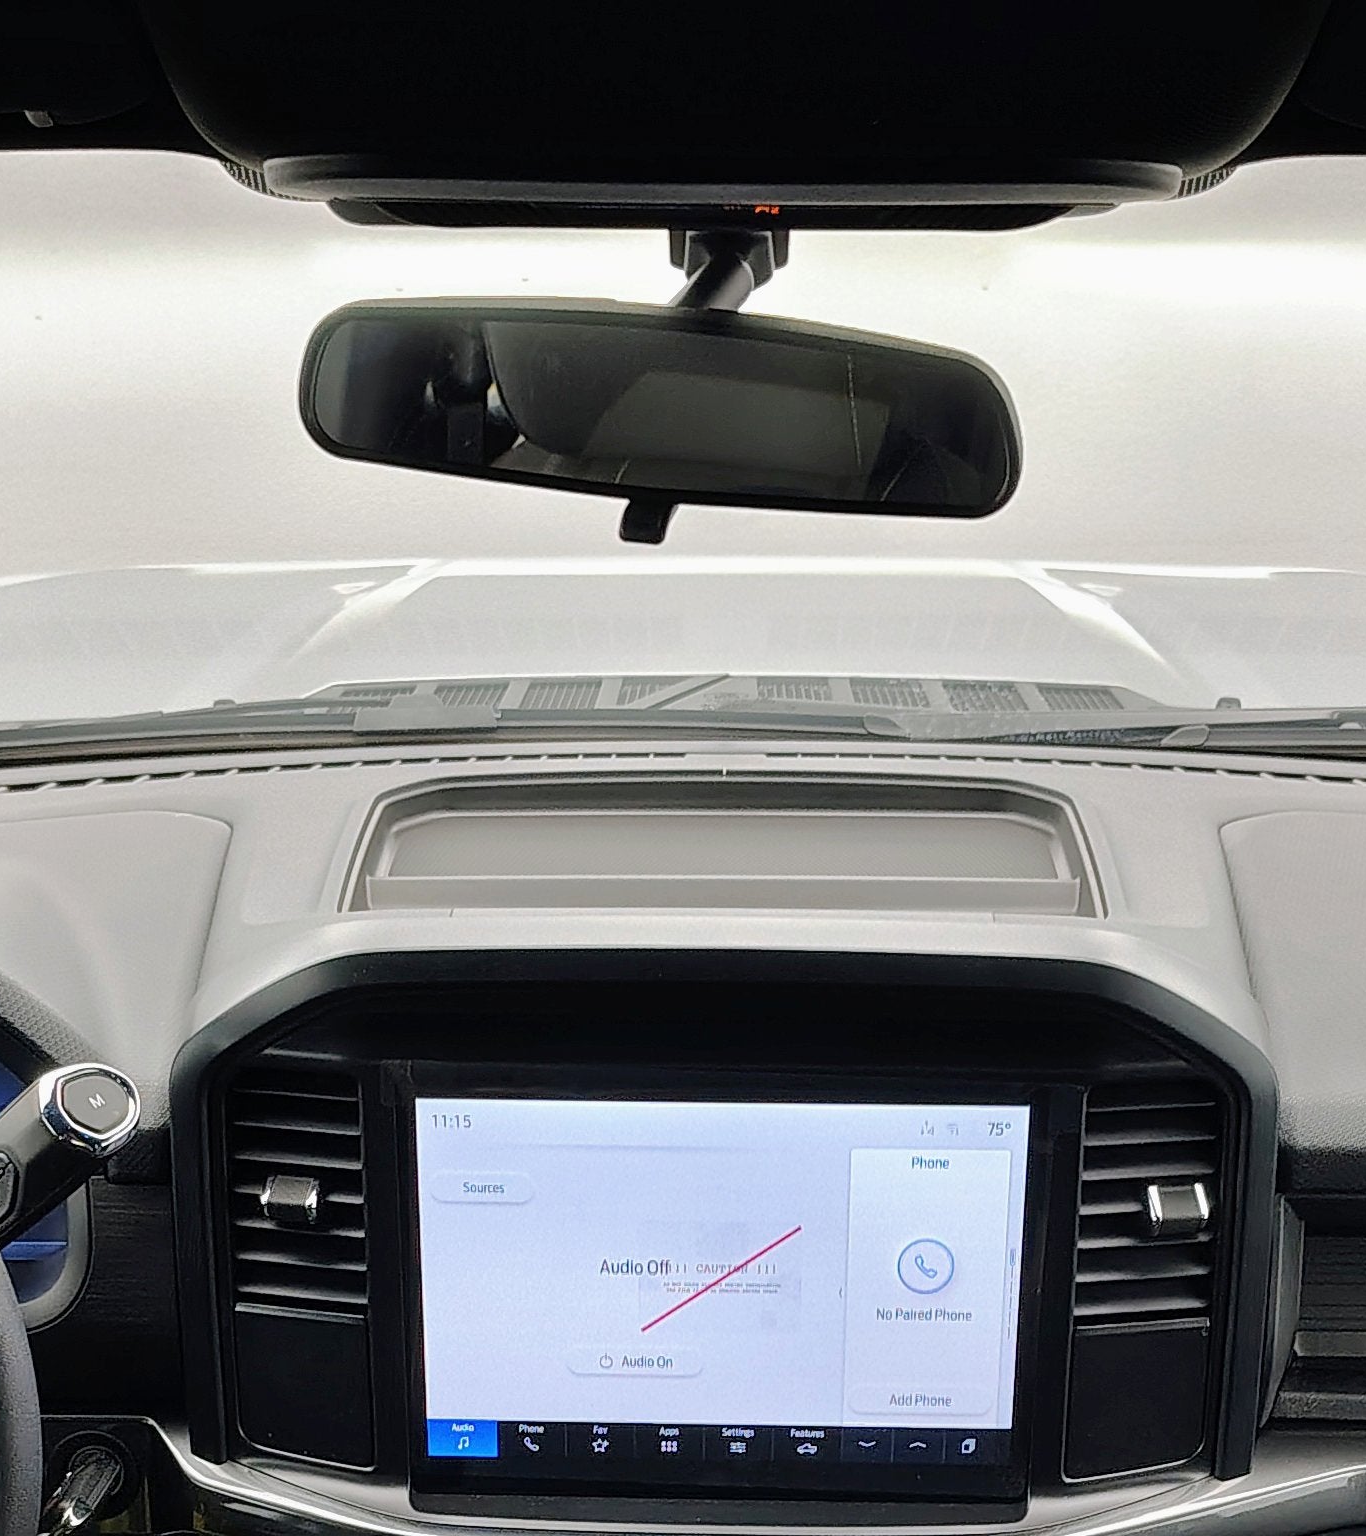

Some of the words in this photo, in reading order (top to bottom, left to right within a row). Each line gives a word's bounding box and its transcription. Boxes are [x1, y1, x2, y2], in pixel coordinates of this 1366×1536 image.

[88, 1093, 106, 1109] M
[431, 1113, 472, 1129] 11:15
[987, 1122, 1012, 1137] 75°
[911, 1155, 950, 1170] Phone
[462, 1181, 505, 1194] Sources
[599, 1258, 644, 1276] Audio
[647, 1258, 670, 1276] Off
[876, 1307, 893, 1321] No
[895, 1306, 933, 1321] Paired
[935, 1307, 973, 1322] Phone
[621, 1355, 654, 1369] Audio
[656, 1355, 673, 1369] On
[889, 1393, 913, 1407] Add
[915, 1394, 953, 1408] Phone
[451, 1423, 475, 1432] Audio
[518, 1424, 545, 1434] Phone
[659, 1427, 680, 1438] Apps
[721, 1427, 755, 1439] Settings
[790, 1428, 825, 1439] Features
